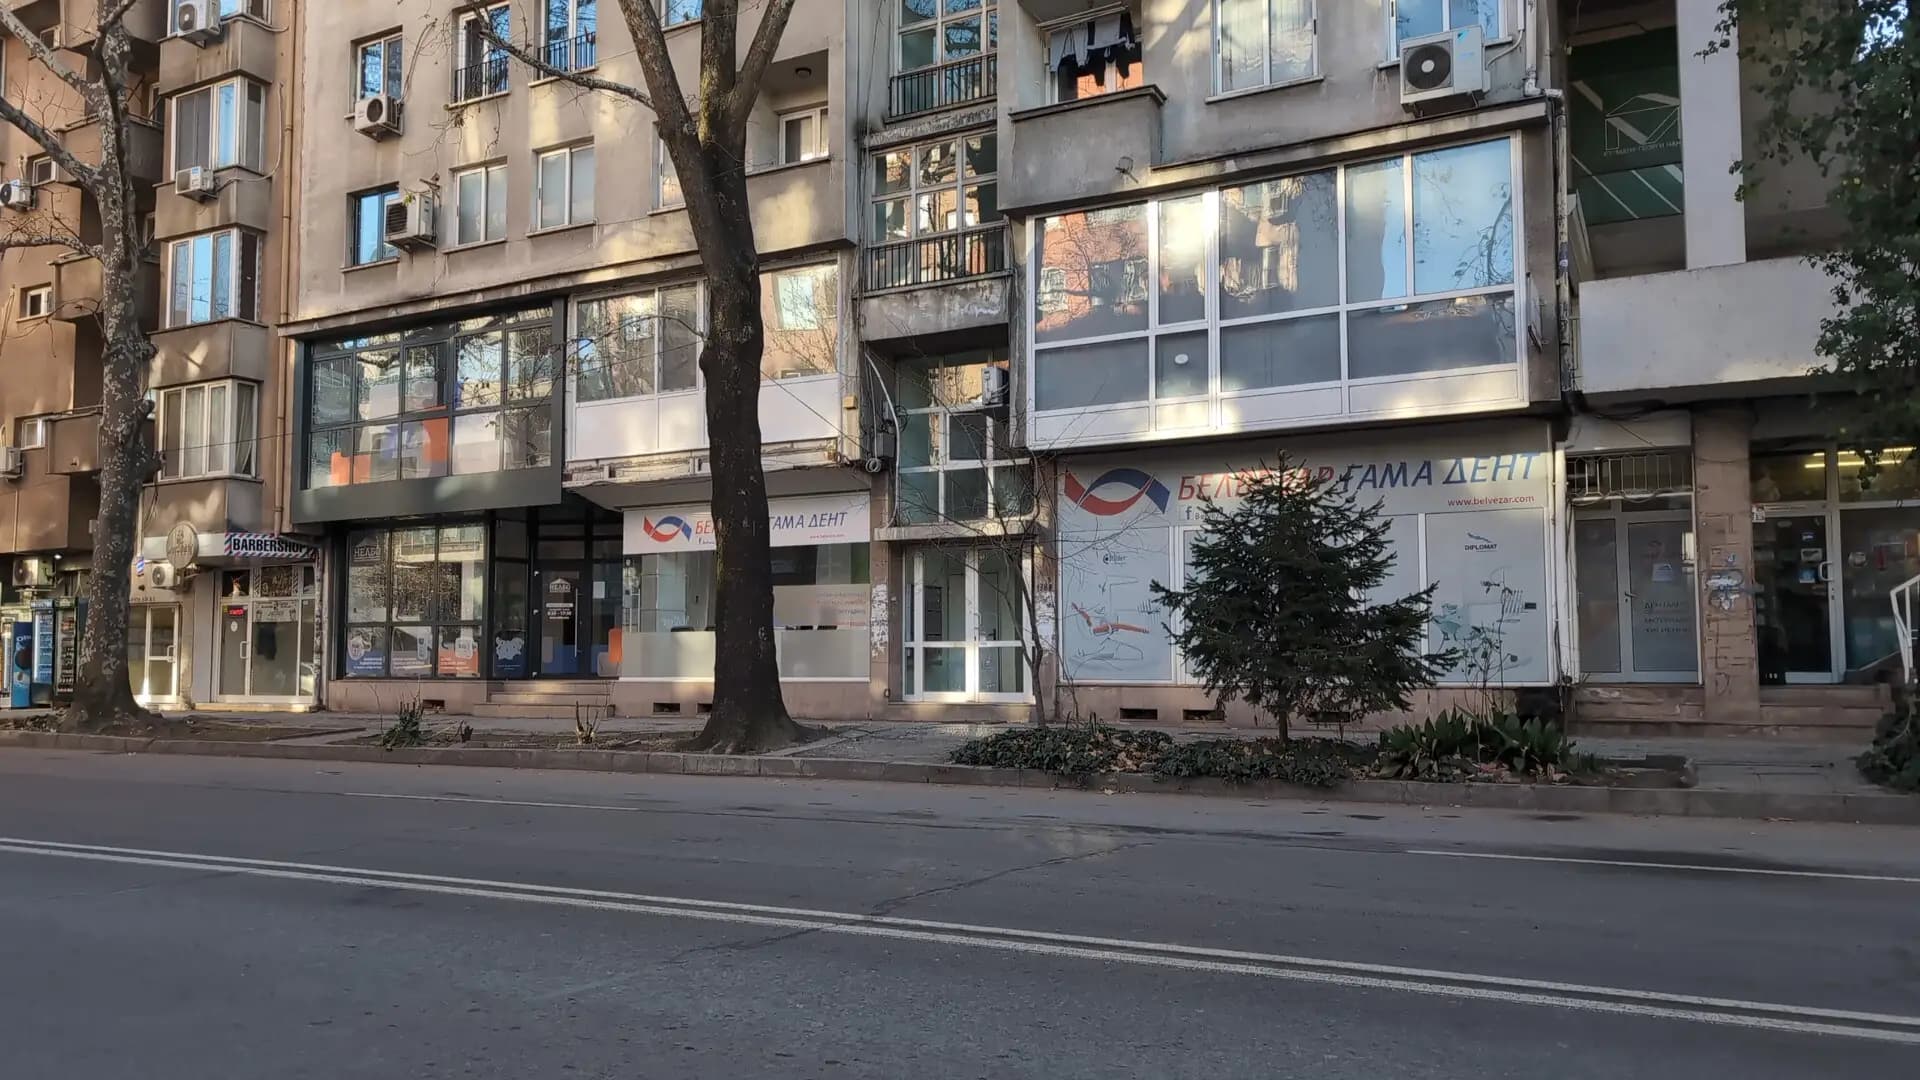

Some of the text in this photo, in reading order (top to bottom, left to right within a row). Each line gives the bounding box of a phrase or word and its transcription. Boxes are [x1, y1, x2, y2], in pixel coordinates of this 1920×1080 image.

[1343, 460, 1433, 490] ГАМА
[1442, 452, 1541, 484] ДЕНТ
[1447, 494, 1535, 507] www.belvezar.com
[768, 512, 848, 531] АМА ДЕНТ
[232, 538, 305, 553] BARBERSHOP
[1464, 543, 1498, 551] DIPLOMAT
